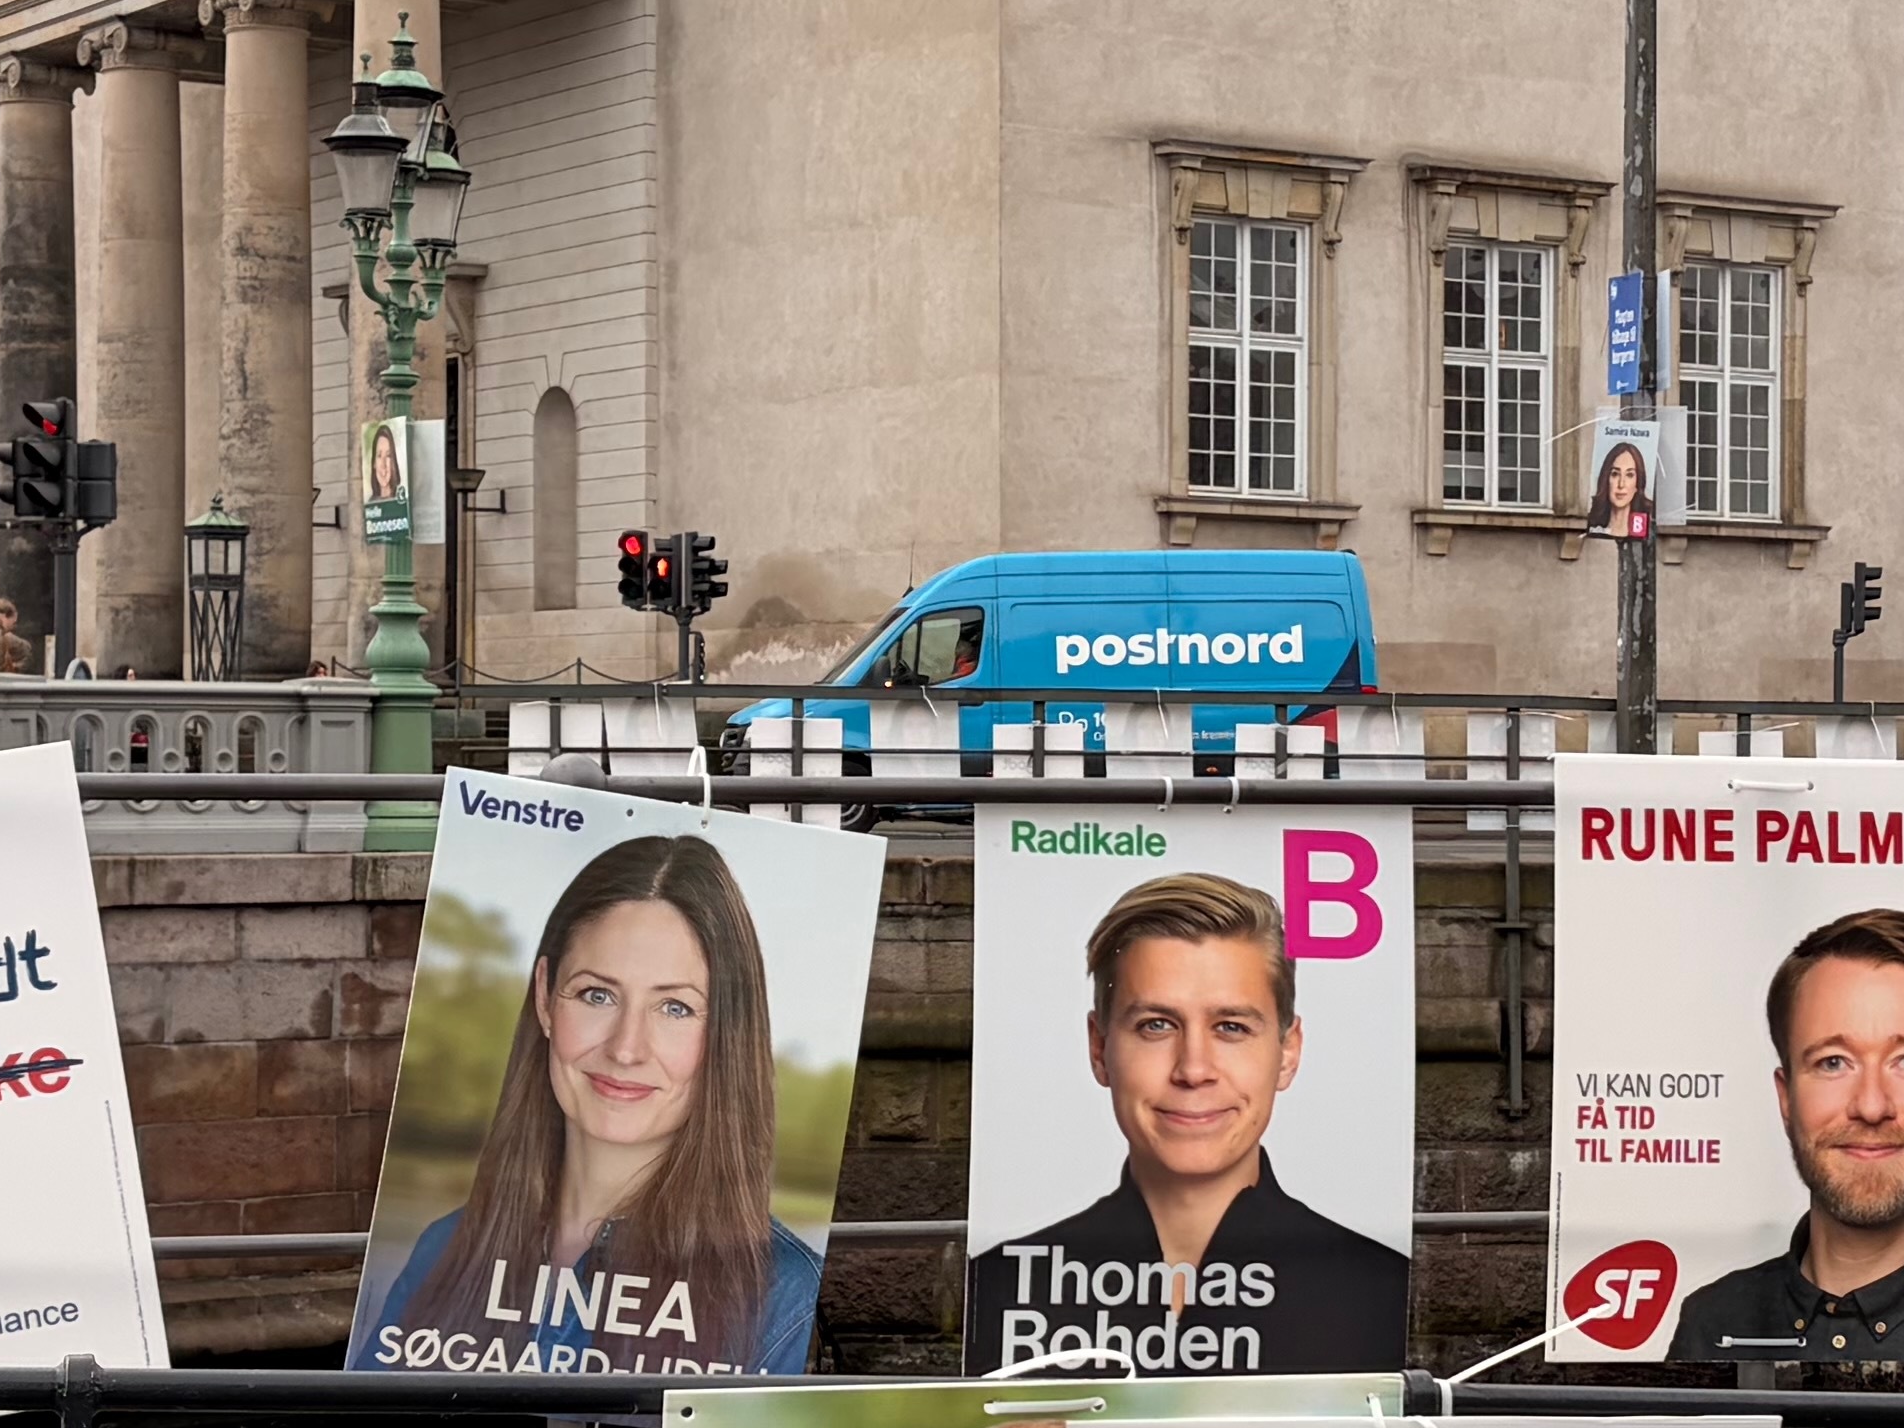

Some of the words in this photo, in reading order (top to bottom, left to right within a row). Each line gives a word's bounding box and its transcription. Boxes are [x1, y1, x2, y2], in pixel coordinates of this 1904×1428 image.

[1057, 625, 1303, 673] postnord
[460, 778, 591, 832] Venstre
[1582, 808, 1735, 863] RUNE
[1757, 811, 1904, 865] PALM
[1012, 821, 1166, 857] Radikale
[1283, 830, 1383, 961] B
[1577, 1074, 1602, 1099] VI
[1606, 1074, 1656, 1099] KAN
[1660, 1074, 1724, 1098] GODT
[1578, 1098, 1607, 1128] FÅ
[1617, 1106, 1655, 1130] TID
[1577, 1139, 1610, 1163] TIL
[1622, 1140, 1718, 1164] FAMILIE
[485, 1259, 696, 1343] LINEA
[1002, 1245, 1275, 1307] Thomas
[1593, 1266, 1660, 1318] SF
[1002, 1310, 1260, 1370] Rohden
